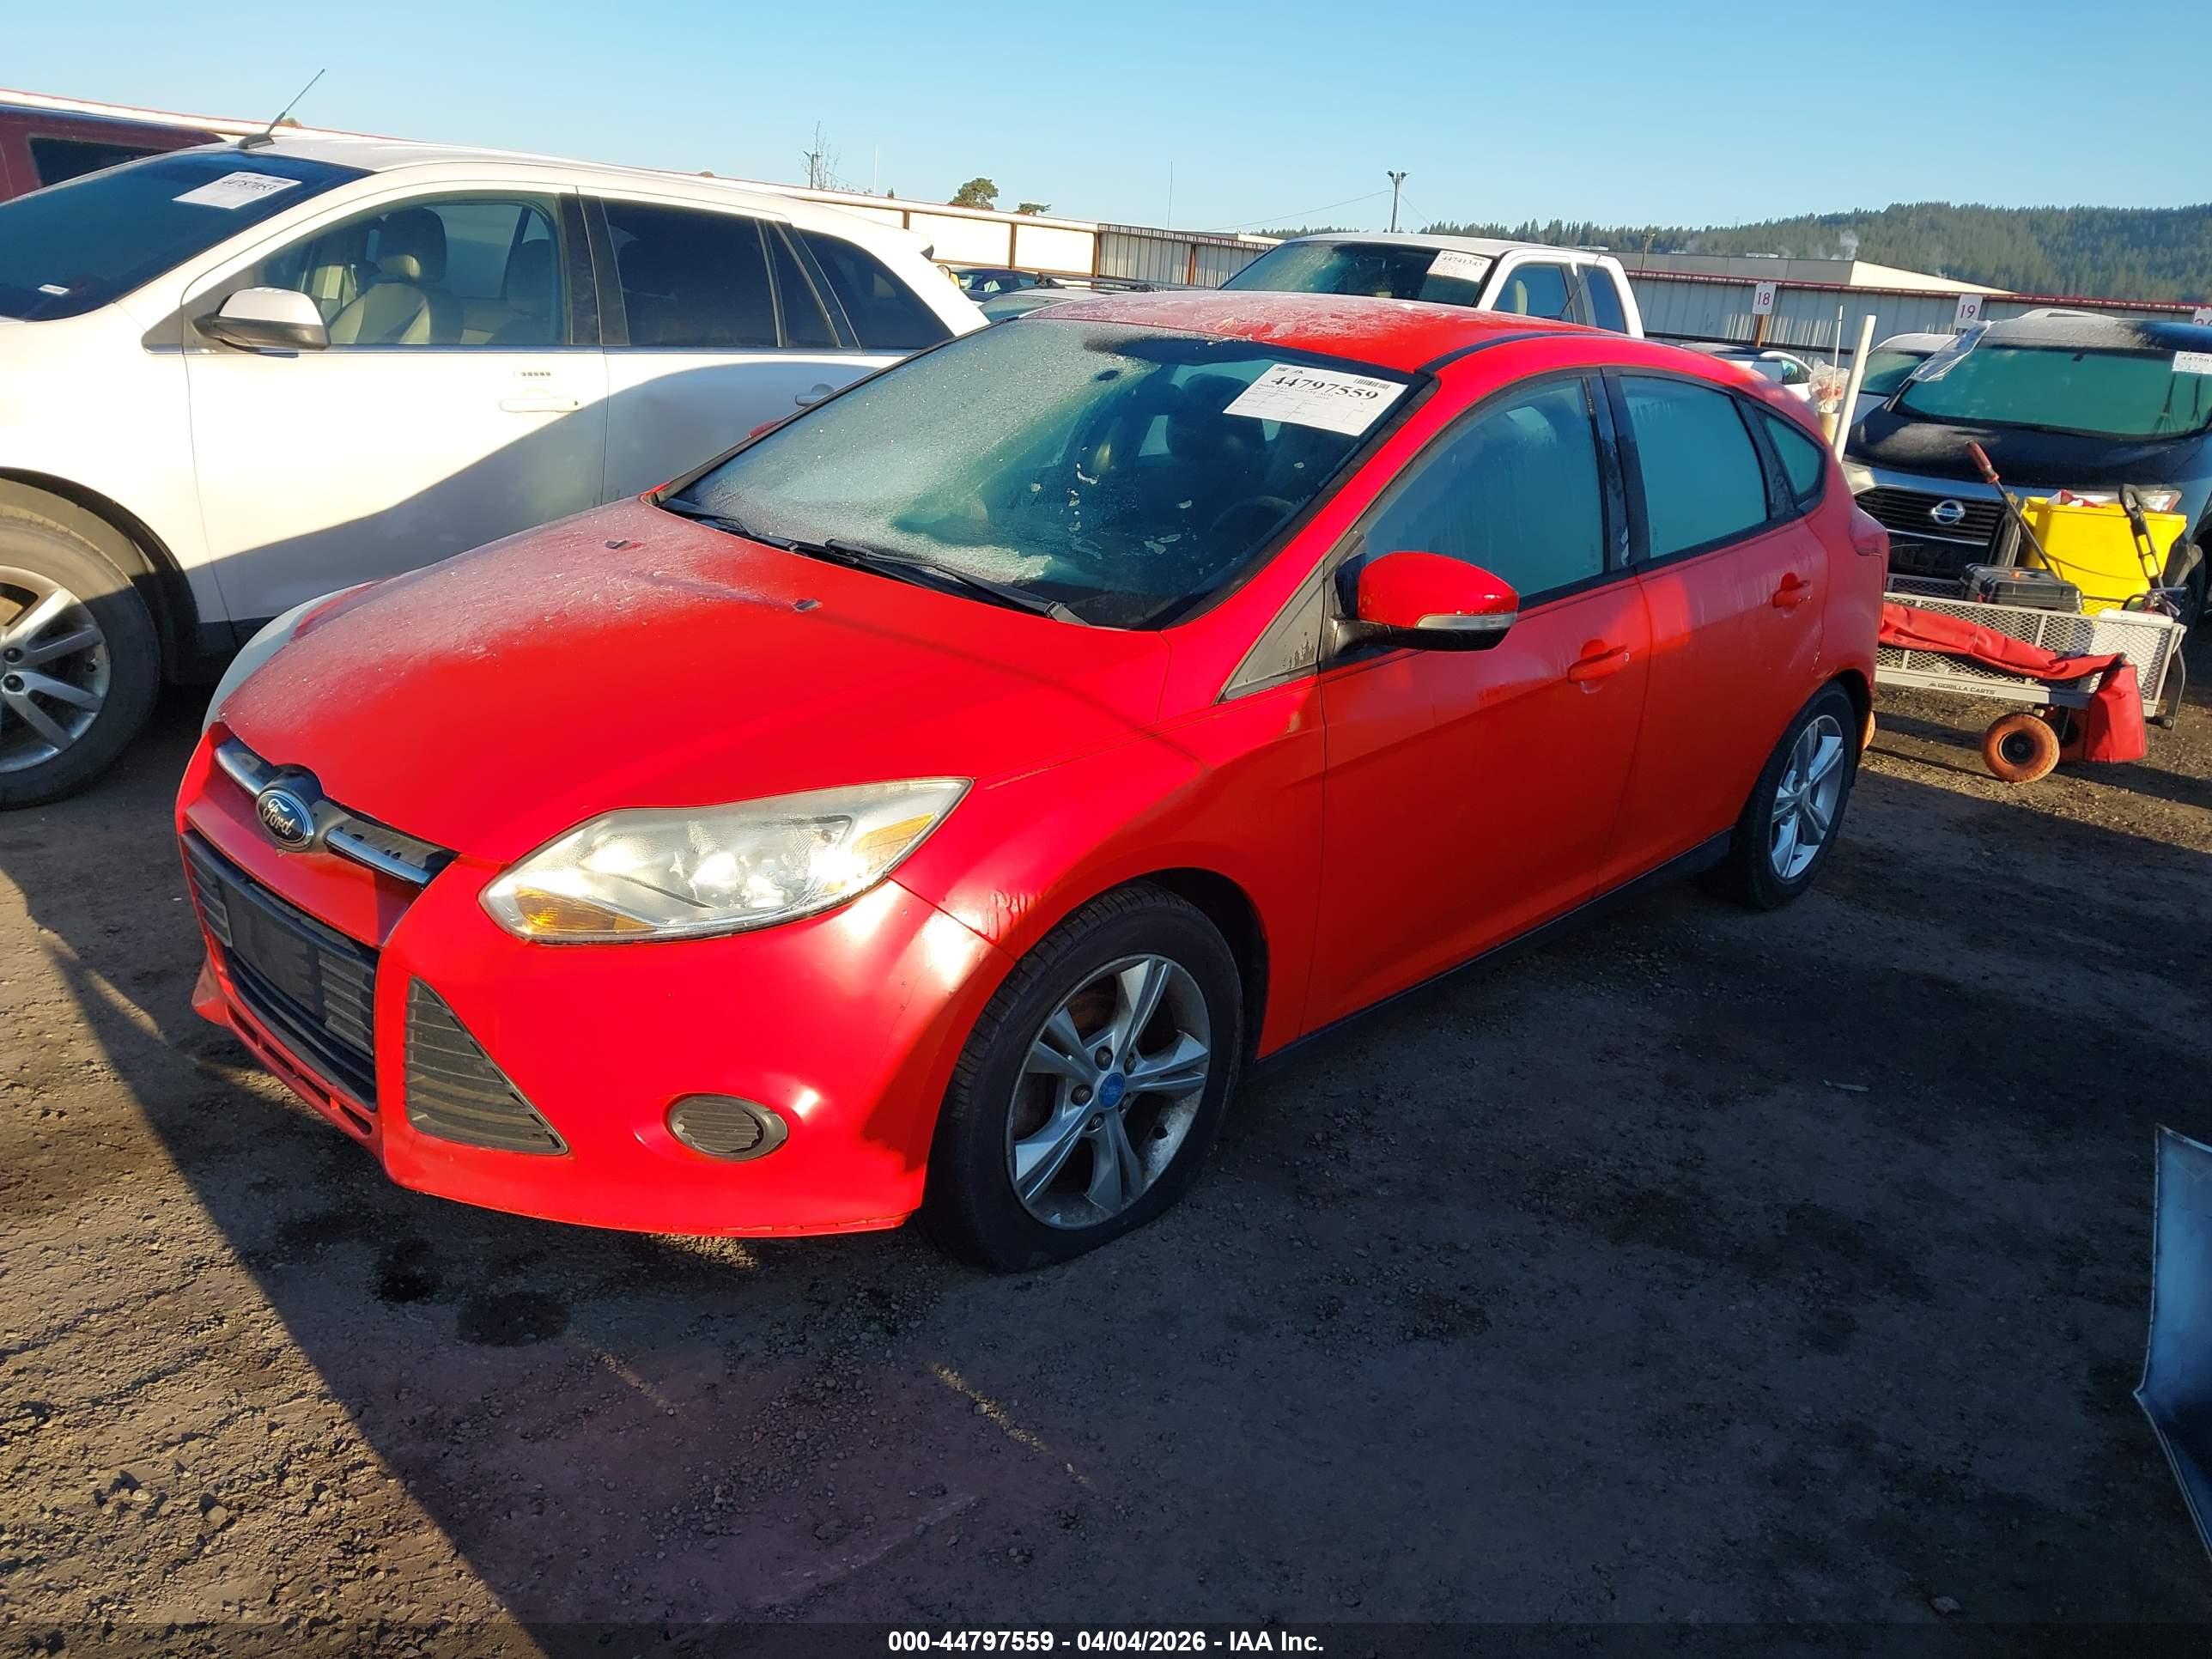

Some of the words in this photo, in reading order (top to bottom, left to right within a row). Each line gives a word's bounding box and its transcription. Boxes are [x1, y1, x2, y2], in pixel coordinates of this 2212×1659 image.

[1757, 292, 1771, 306] 18
[1960, 304, 1976, 319] 19
[1270, 375, 1379, 401] 44797559
[1937, 682, 1968, 691] GORILLA
[263, 798, 296, 836] Ford
